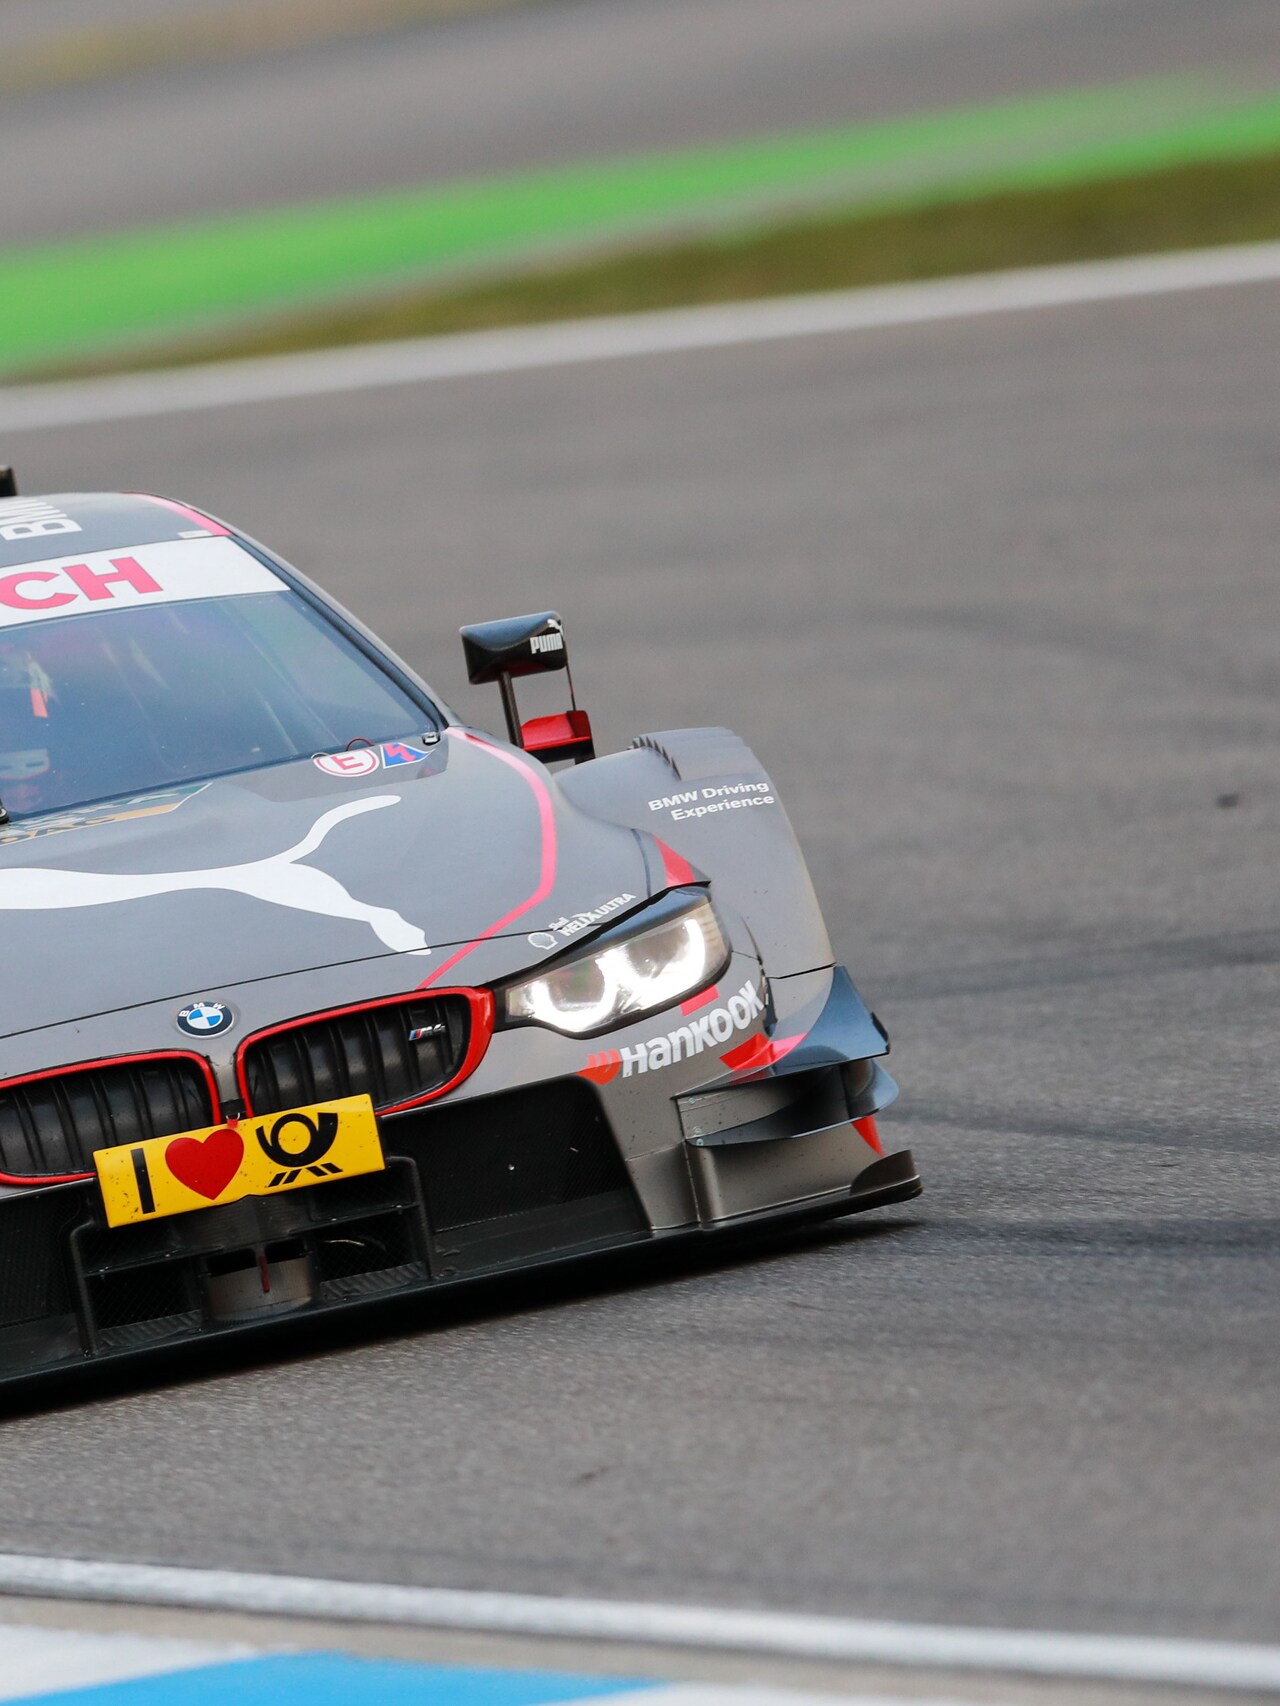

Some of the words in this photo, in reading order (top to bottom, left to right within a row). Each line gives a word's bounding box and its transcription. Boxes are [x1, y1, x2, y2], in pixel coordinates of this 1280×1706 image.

[529, 632, 564, 655] PUMA
[648, 791, 698, 811] BMW
[701, 782, 770, 799] Driving
[670, 795, 775, 821] Experience
[595, 893, 637, 916] ULTRA
[178, 1002, 226, 1017] BMW
